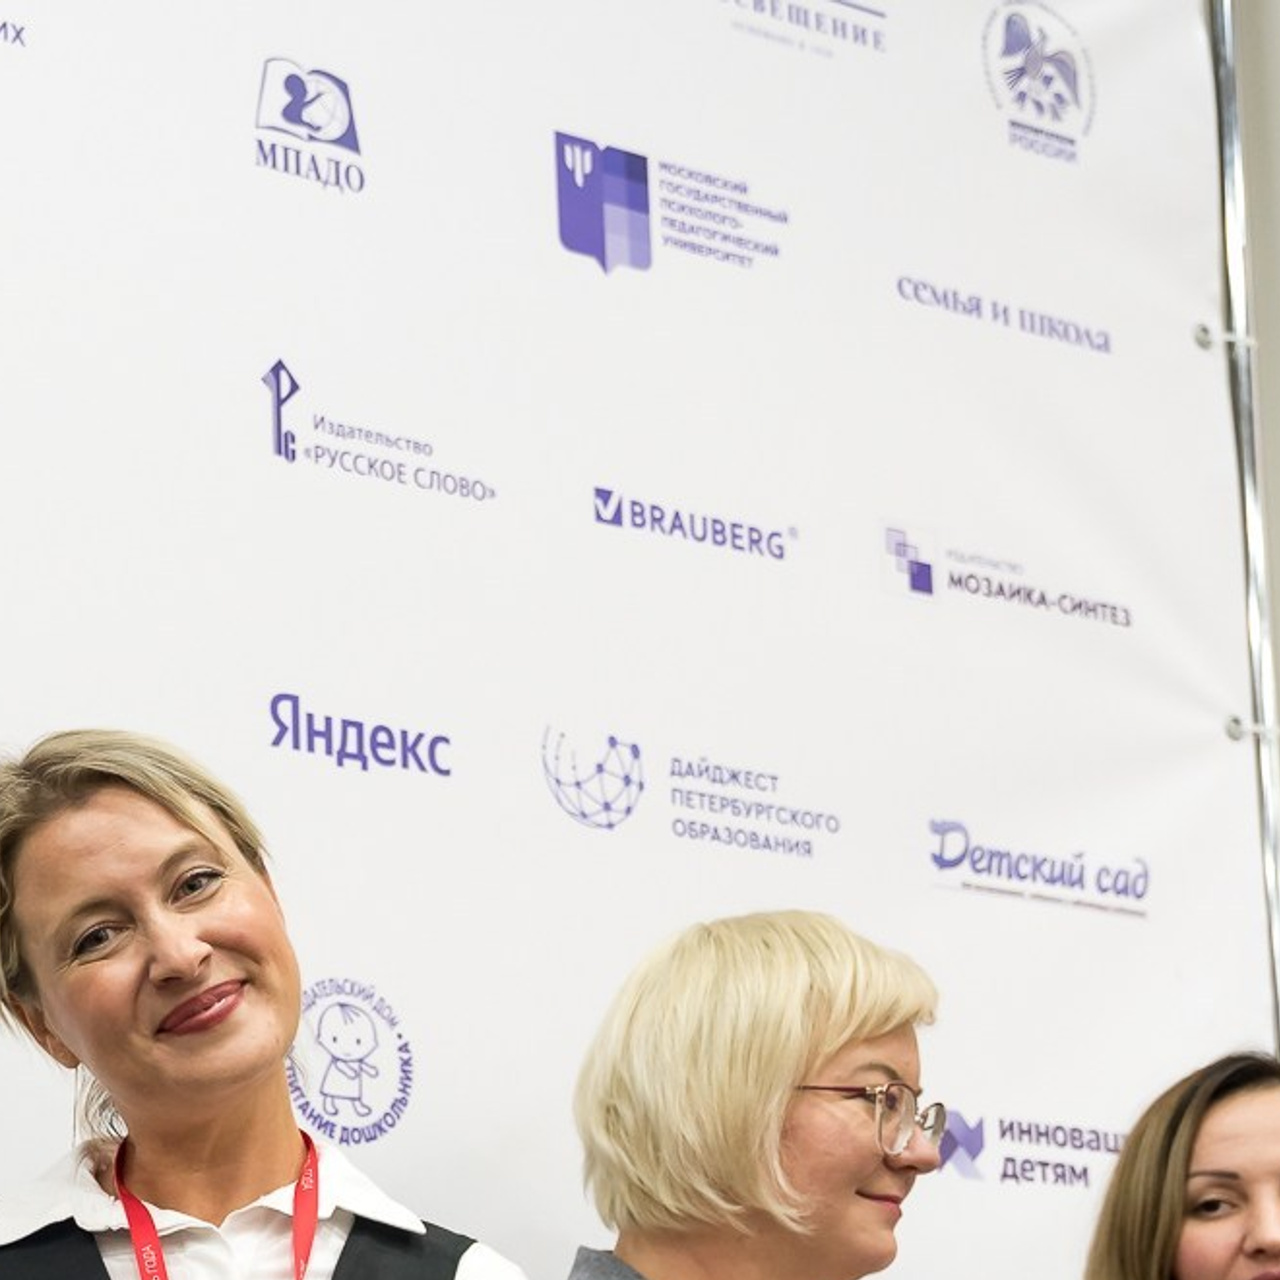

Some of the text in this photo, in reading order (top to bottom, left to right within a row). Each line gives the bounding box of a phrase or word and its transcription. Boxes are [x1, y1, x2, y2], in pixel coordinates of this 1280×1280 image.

[256, 139, 365, 194] МПАДО
[658, 160, 748, 194] МОСКОВСКИЙ
[313, 414, 433, 457] Издательство
[414, 467, 496, 502] СЛОВО»
[630, 499, 786, 560] BRAUBERG
[946, 570, 1133, 628] МОЗАИКА-СИНТЕЗ
[270, 693, 451, 777] Яндекс
[670, 756, 780, 793] ДАЙДЖЕСТ
[671, 787, 841, 834] ПЕТЕРБУРГСКОГО
[671, 817, 814, 857] ОБРАЗОВАНИЯ
[928, 819, 1086, 890] Детский
[1095, 856, 1150, 900] сад
[338, 1041, 414, 1147] ДОШКОЛЬНИКА
[1000, 1156, 1091, 1188] детям
[141, 1243, 158, 1275] ГОДА
